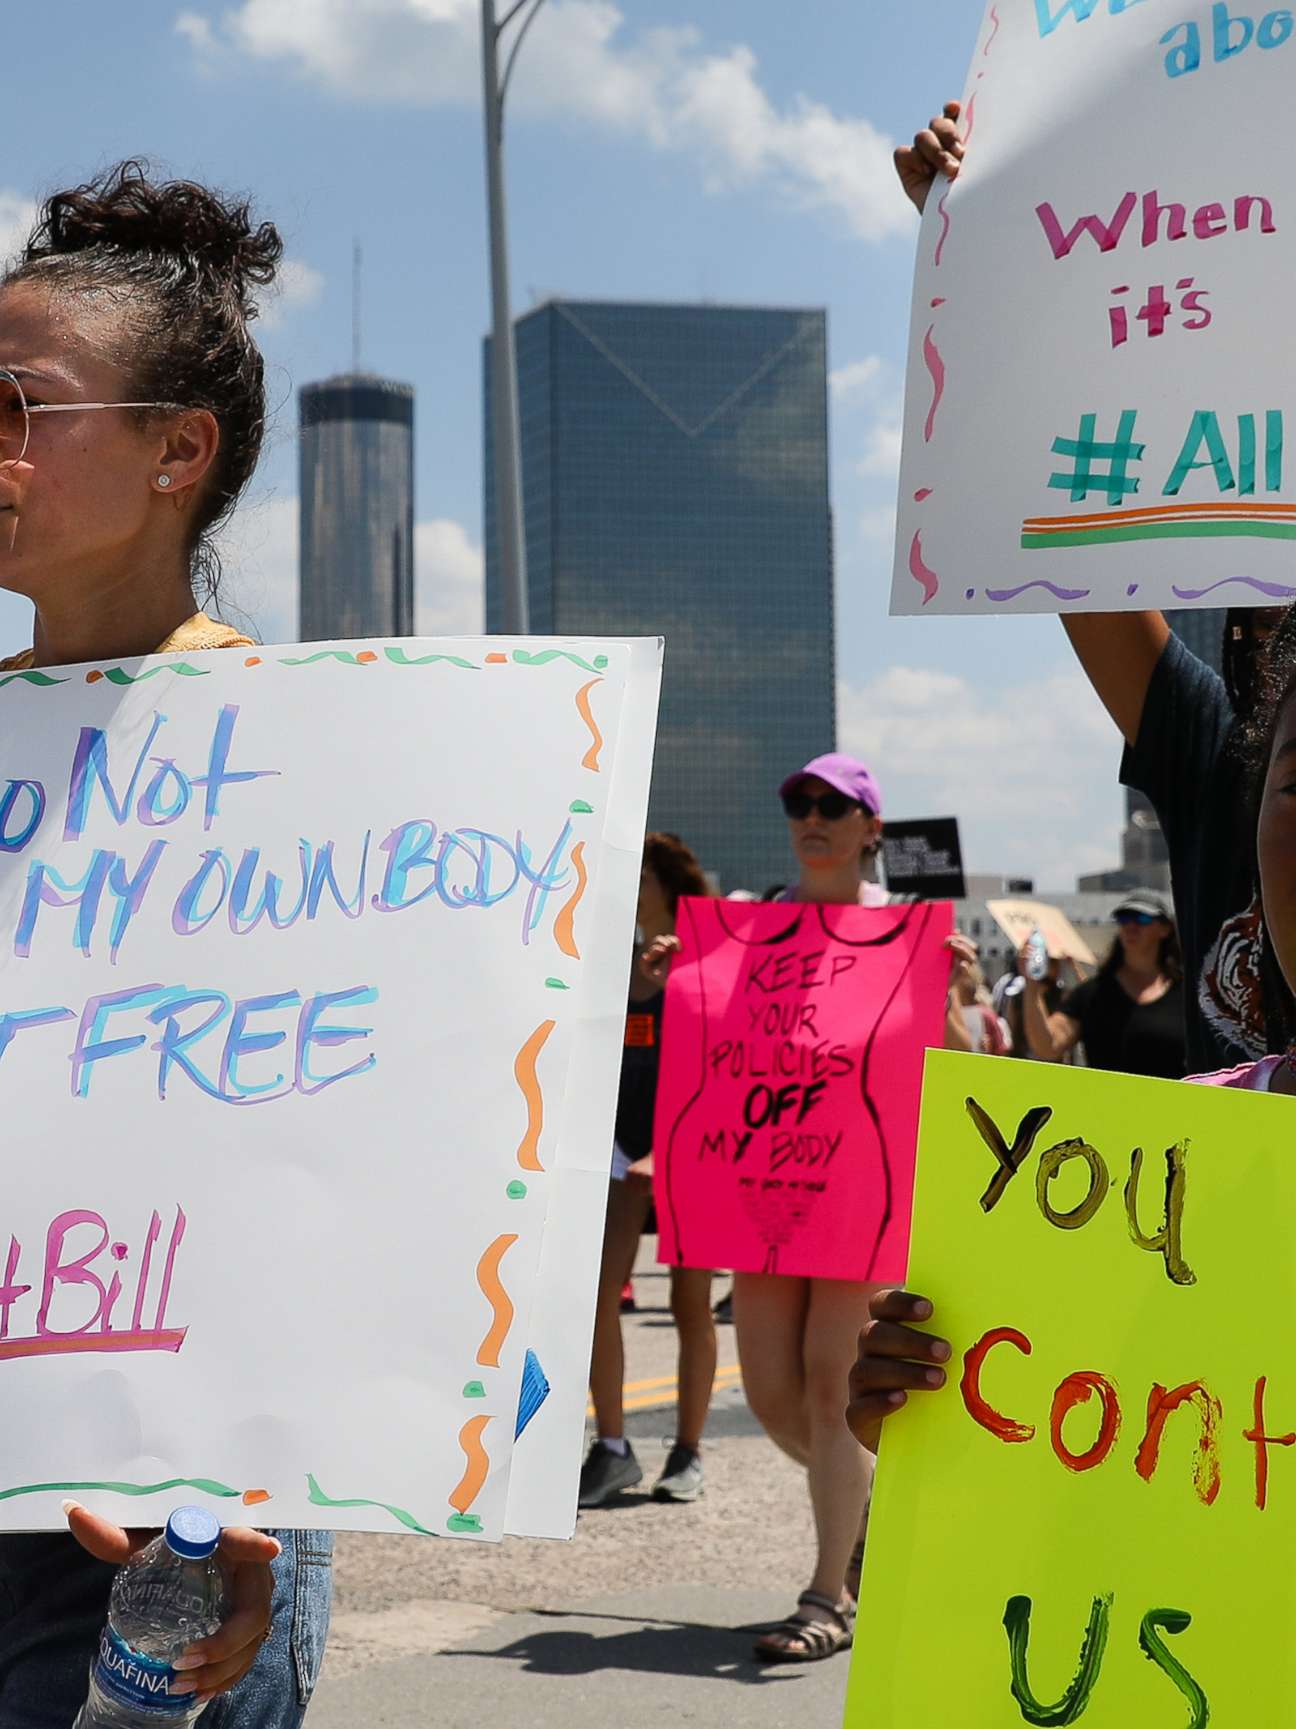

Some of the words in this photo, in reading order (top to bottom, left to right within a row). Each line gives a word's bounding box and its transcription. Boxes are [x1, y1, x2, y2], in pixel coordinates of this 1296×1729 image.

[1036, 190, 1275, 260] When
[1108, 278, 1213, 348] it's
[63, 704, 281, 842] Not
[14, 838, 170, 965] MY
[745, 952, 857, 993] KEEP
[68, 983, 379, 1106] FREE
[748, 1002, 819, 1037] YOUR
[710, 1039, 855, 1079] POLICIES
[743, 1080, 827, 1129] OFF
[698, 1129, 753, 1165] MY
[770, 1131, 843, 1172] BODY
